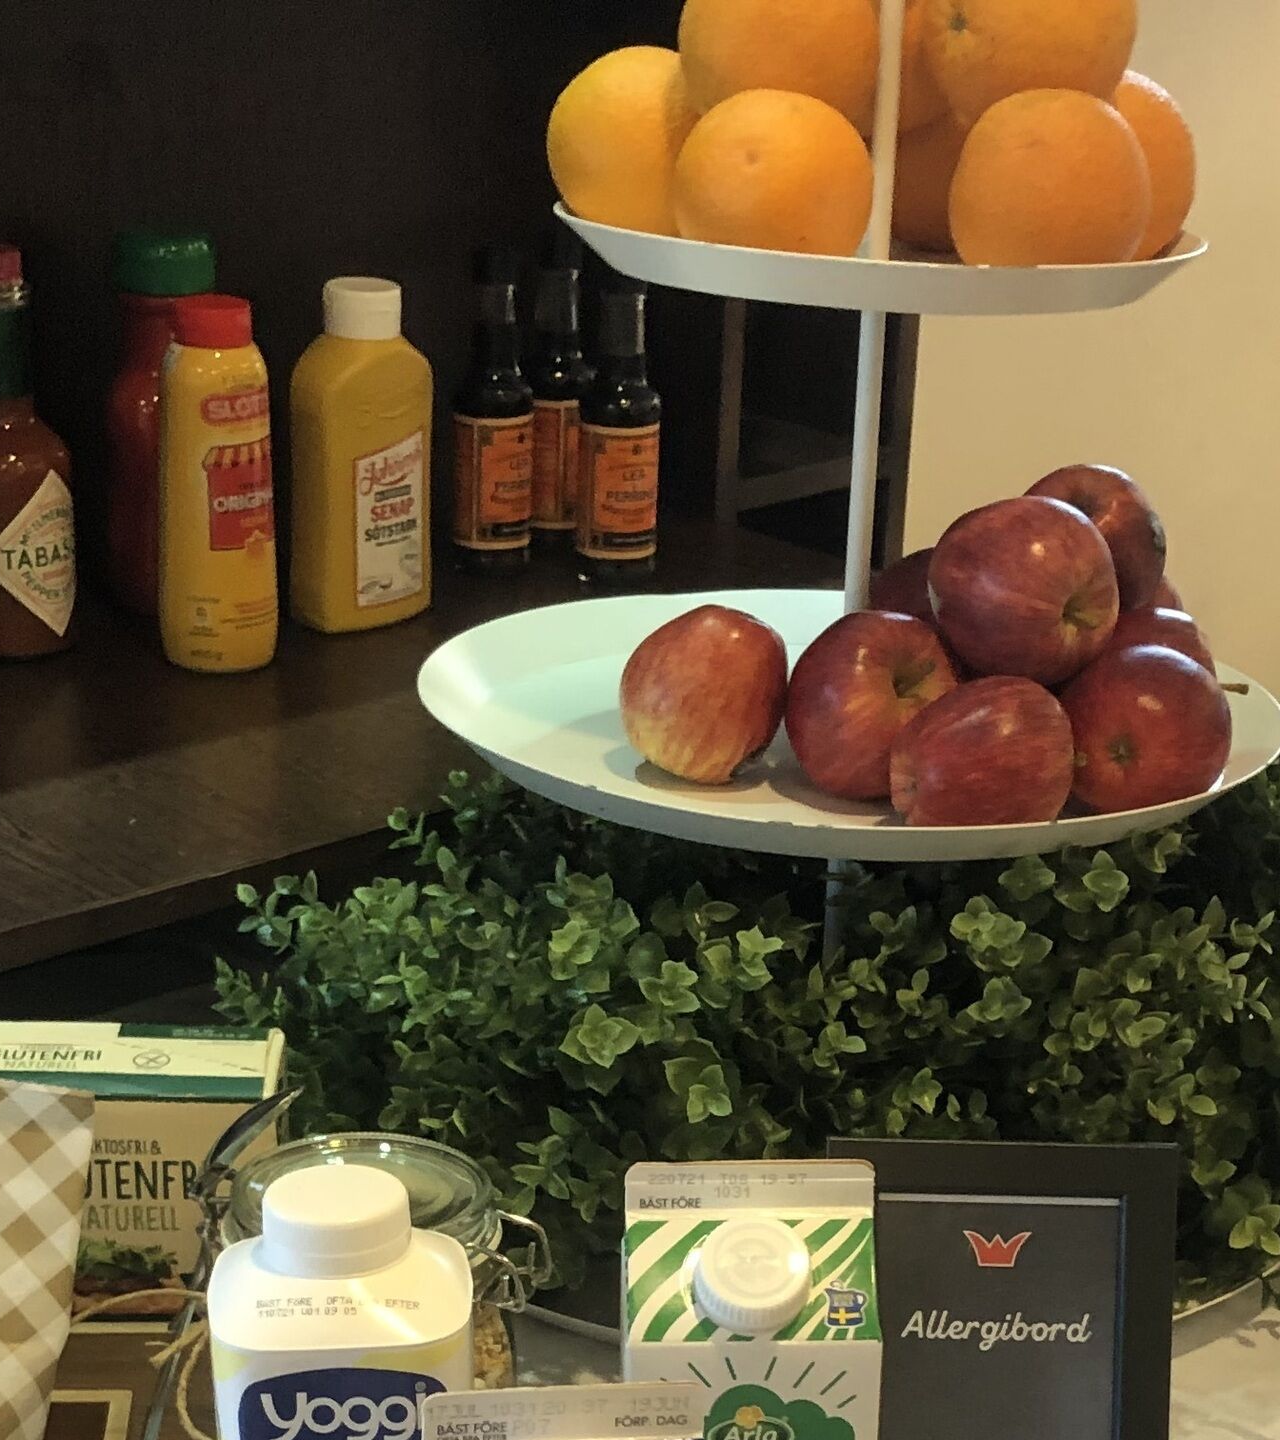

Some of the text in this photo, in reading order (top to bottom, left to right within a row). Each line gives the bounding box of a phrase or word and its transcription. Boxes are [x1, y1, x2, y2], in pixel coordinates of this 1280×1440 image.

[151, 1140, 162, 1155] &
[639, 1196, 701, 1209] BÄST FÖRE
[82, 1203, 181, 1232] ATURELL
[384, 1298, 420, 1310] EFTER
[901, 1309, 1093, 1351] Allergibord
[656, 1414, 689, 1426] DAG
[437, 1422, 470, 1436] BÄST
[473, 1420, 507, 1434] FÖRE
